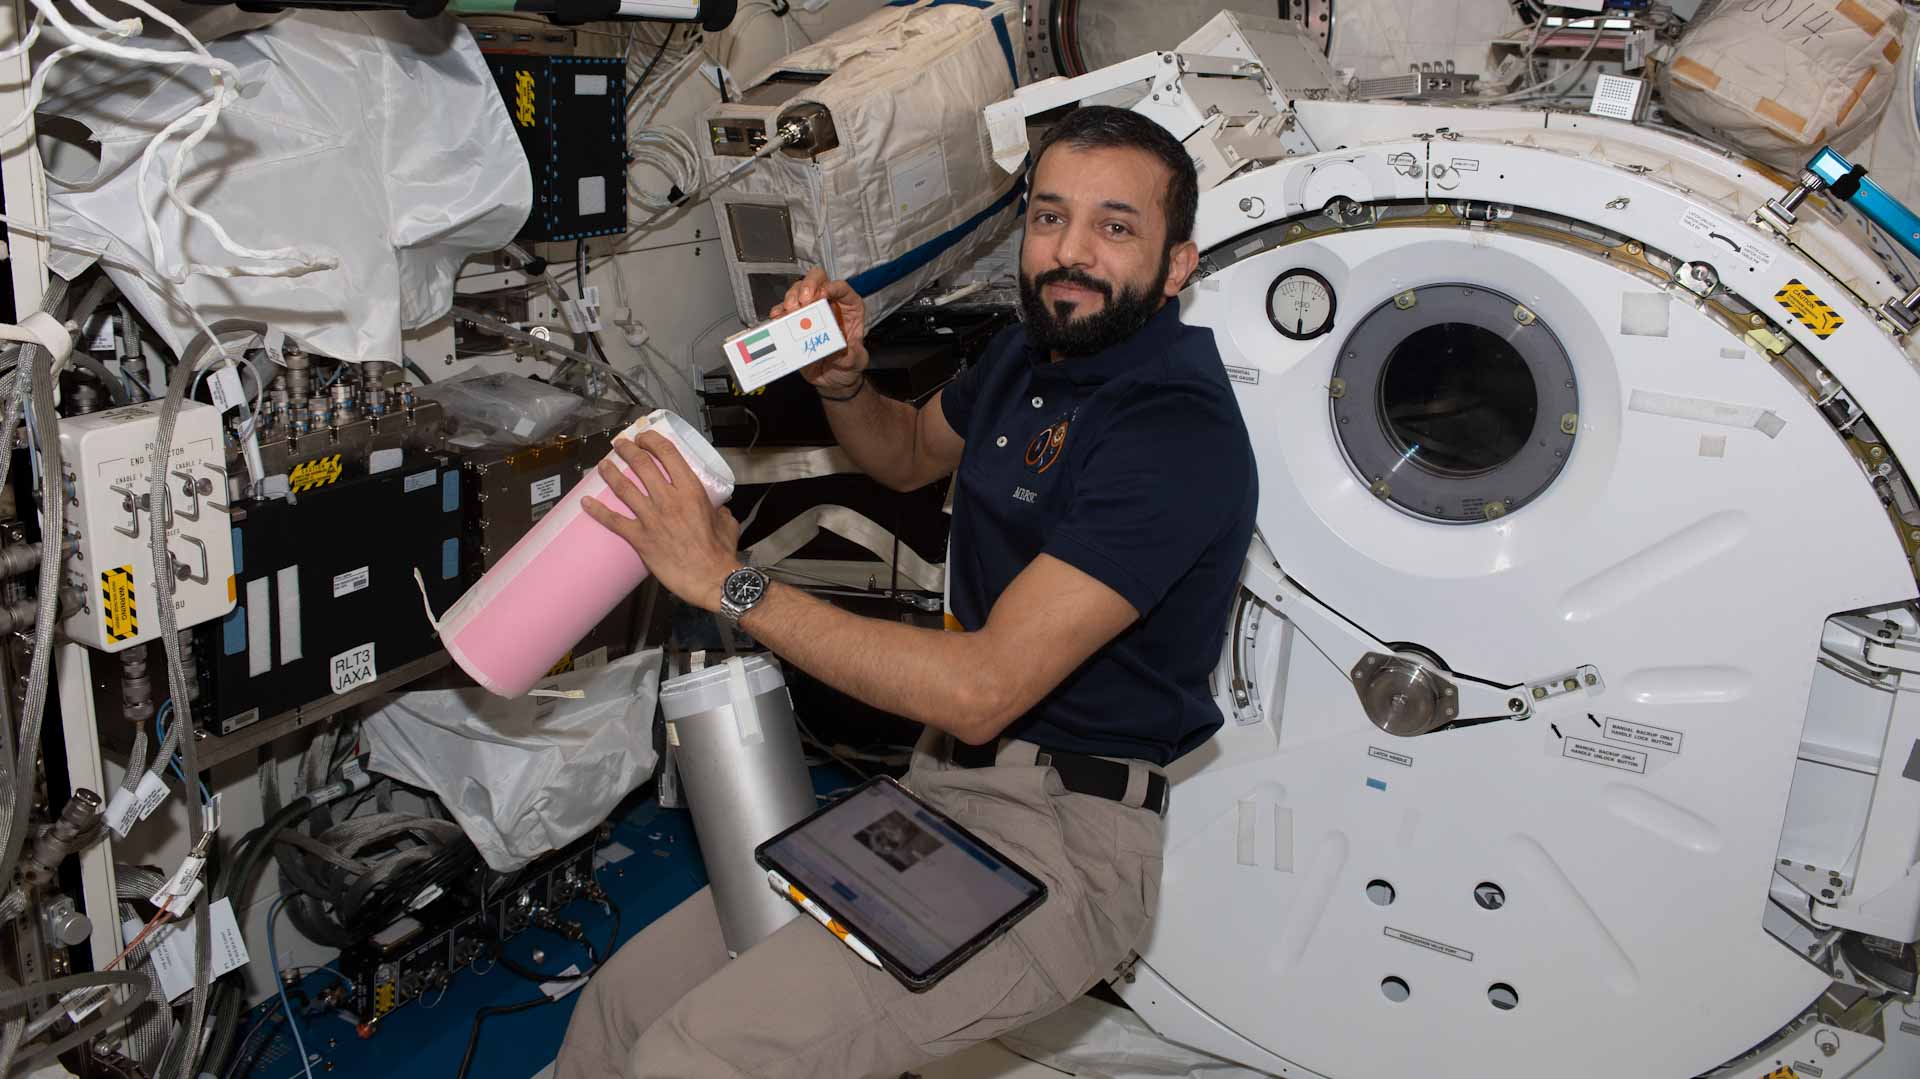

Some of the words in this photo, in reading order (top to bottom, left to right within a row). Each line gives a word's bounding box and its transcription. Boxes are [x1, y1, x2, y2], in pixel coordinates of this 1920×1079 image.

[1792, 289, 1816, 309] CAUTION
[118, 585, 128, 621] WARNING
[335, 649, 370, 674] RLT3
[336, 665, 372, 690] JAXA
[1612, 724, 1634, 733] MANUAL
[1636, 728, 1658, 738] BACKUP
[1660, 733, 1674, 741] ONLY
[1575, 744, 1596, 752] MANUAL
[1598, 749, 1620, 757] BACKUP
